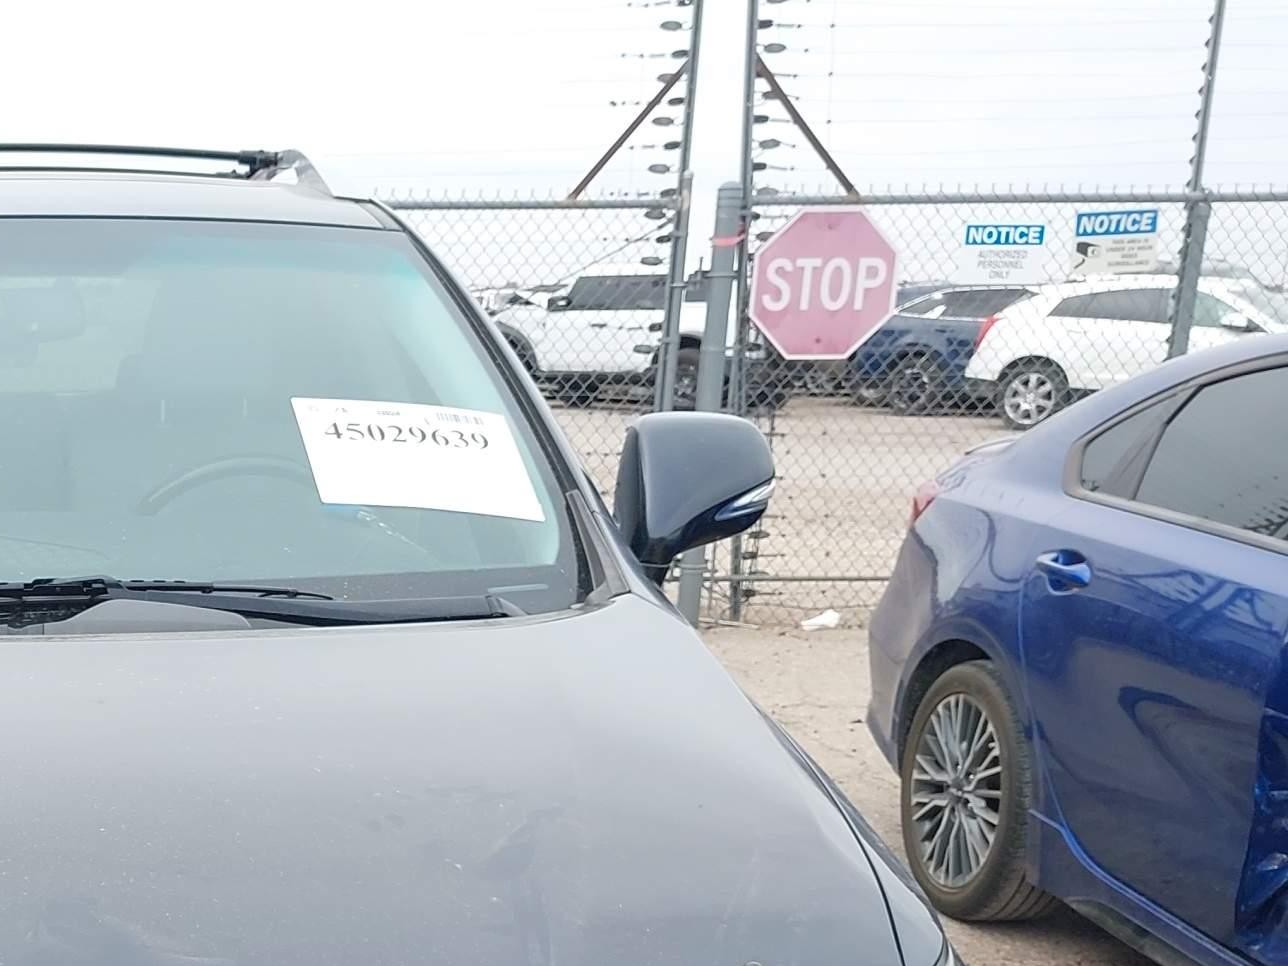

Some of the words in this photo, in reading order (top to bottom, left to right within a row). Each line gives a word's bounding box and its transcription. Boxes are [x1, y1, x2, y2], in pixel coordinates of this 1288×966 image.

[1078, 212, 1155, 234] NOTICE
[967, 226, 1042, 244] NOTICE
[977, 260, 1024, 269] PERSONNEL
[988, 270, 1010, 279] ONLY
[762, 257, 887, 312] STOP
[324, 422, 489, 450] 45029639
